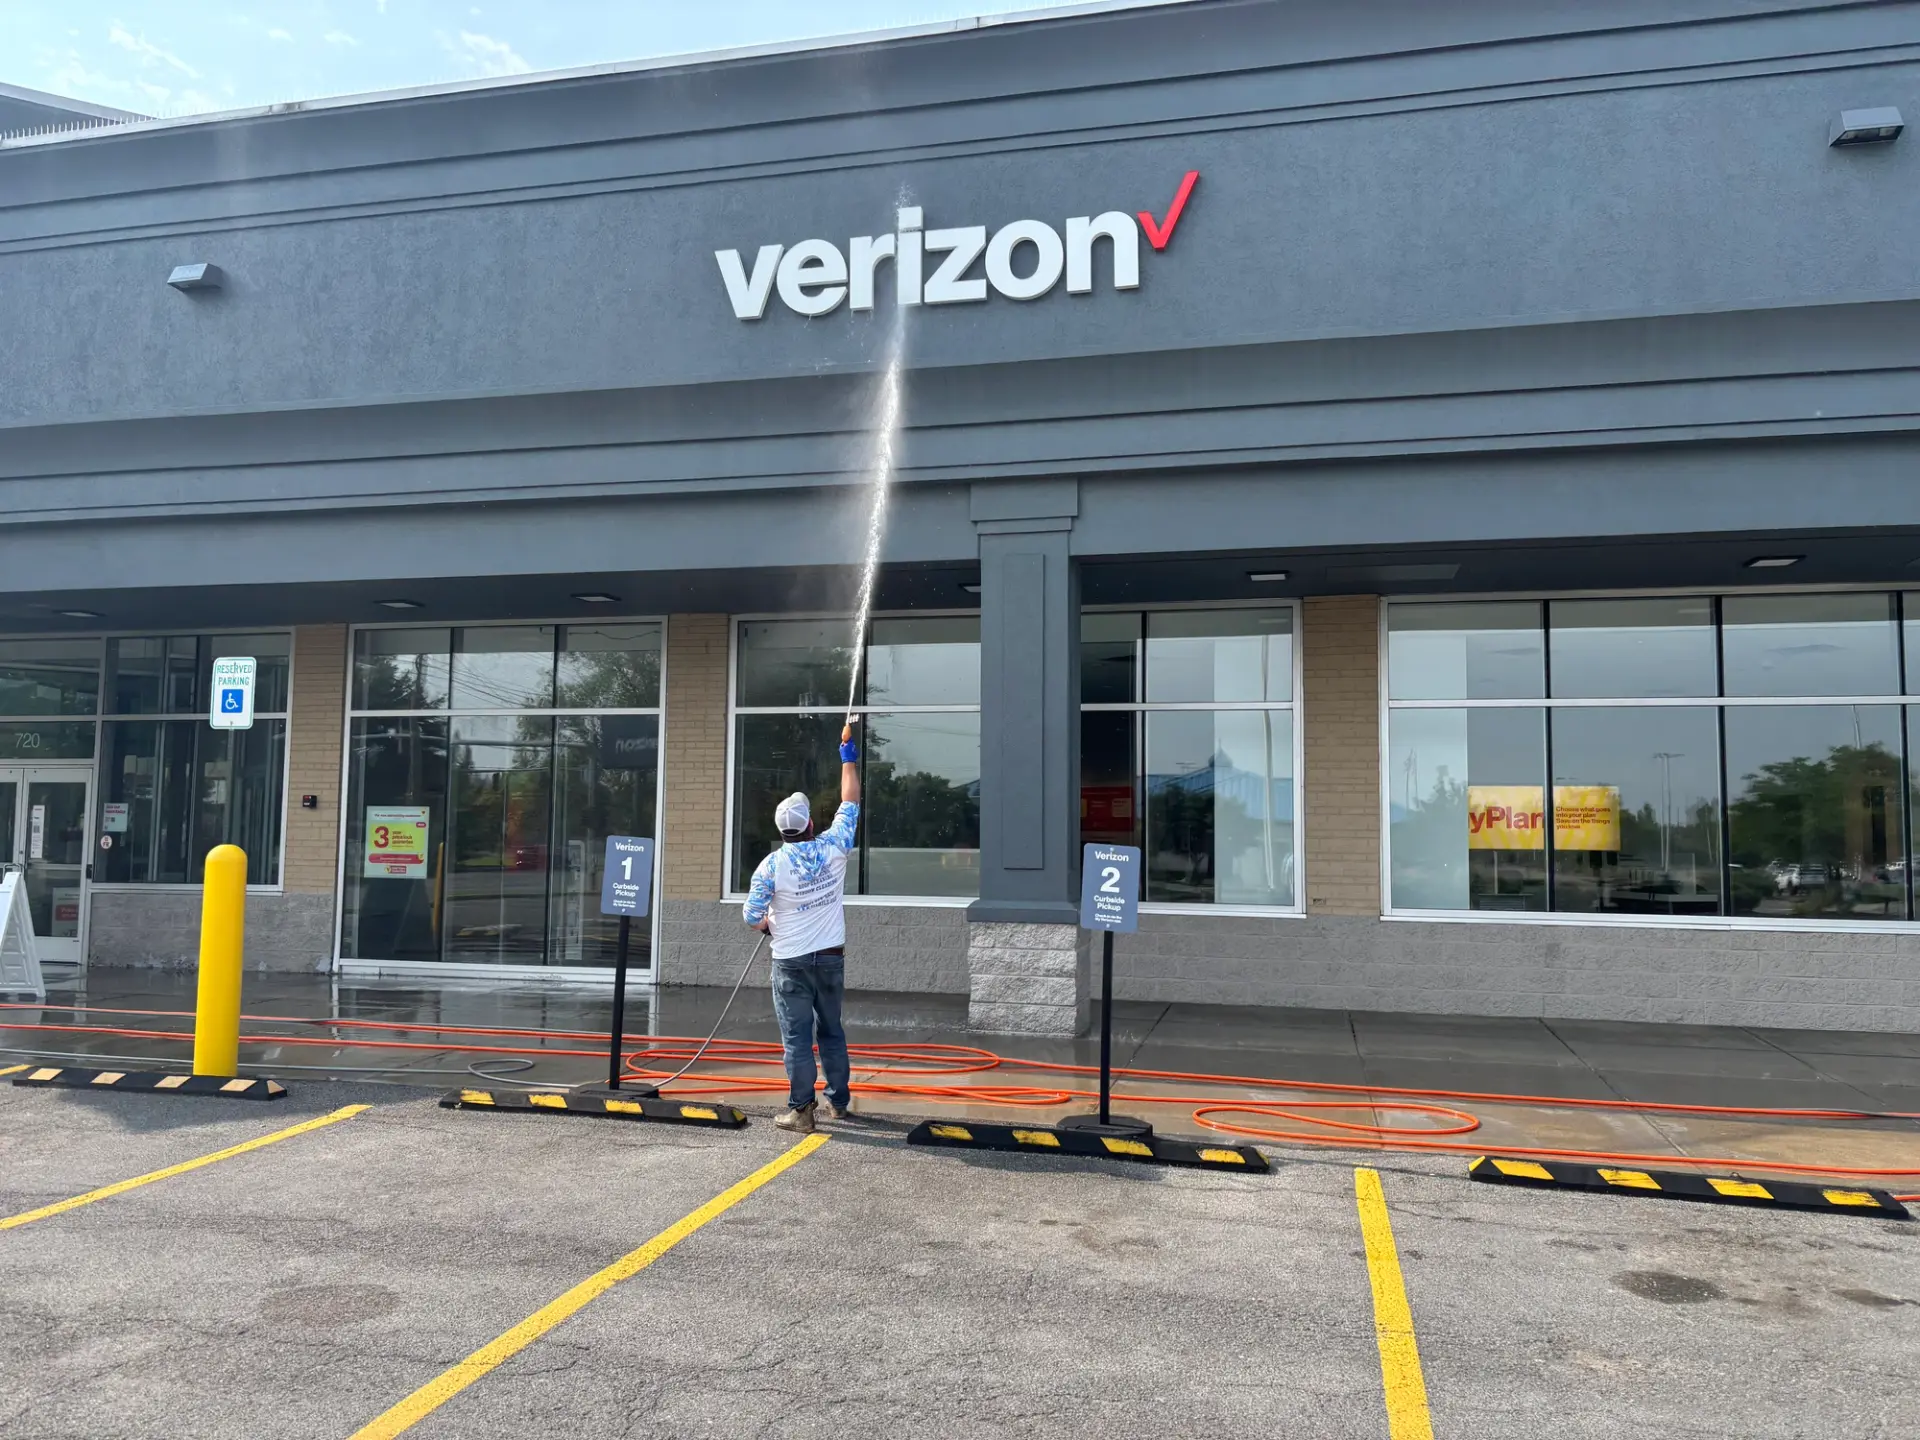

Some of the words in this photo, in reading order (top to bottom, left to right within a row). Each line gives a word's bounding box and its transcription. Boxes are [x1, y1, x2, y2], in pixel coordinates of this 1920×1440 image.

[714, 206, 1140, 321] verizon
[217, 664, 252, 673] RESERVED
[218, 677, 250, 686] PARKING
[15, 733, 40, 748] 720
[1468, 806, 1544, 833] yPlan
[374, 826, 389, 848] 3
[615, 842, 644, 852] Verizon
[1094, 850, 1129, 862] Verizon
[621, 857, 632, 880] 1
[1100, 866, 1121, 893] 2
[612, 882, 640, 891] Curbside
[795, 887, 815, 896] WINDOW
[816, 878, 838, 891] CLEANING
[615, 889, 636, 898] Pickup
[1093, 895, 1125, 904] Curbside
[1096, 902, 1121, 912] Pickup
